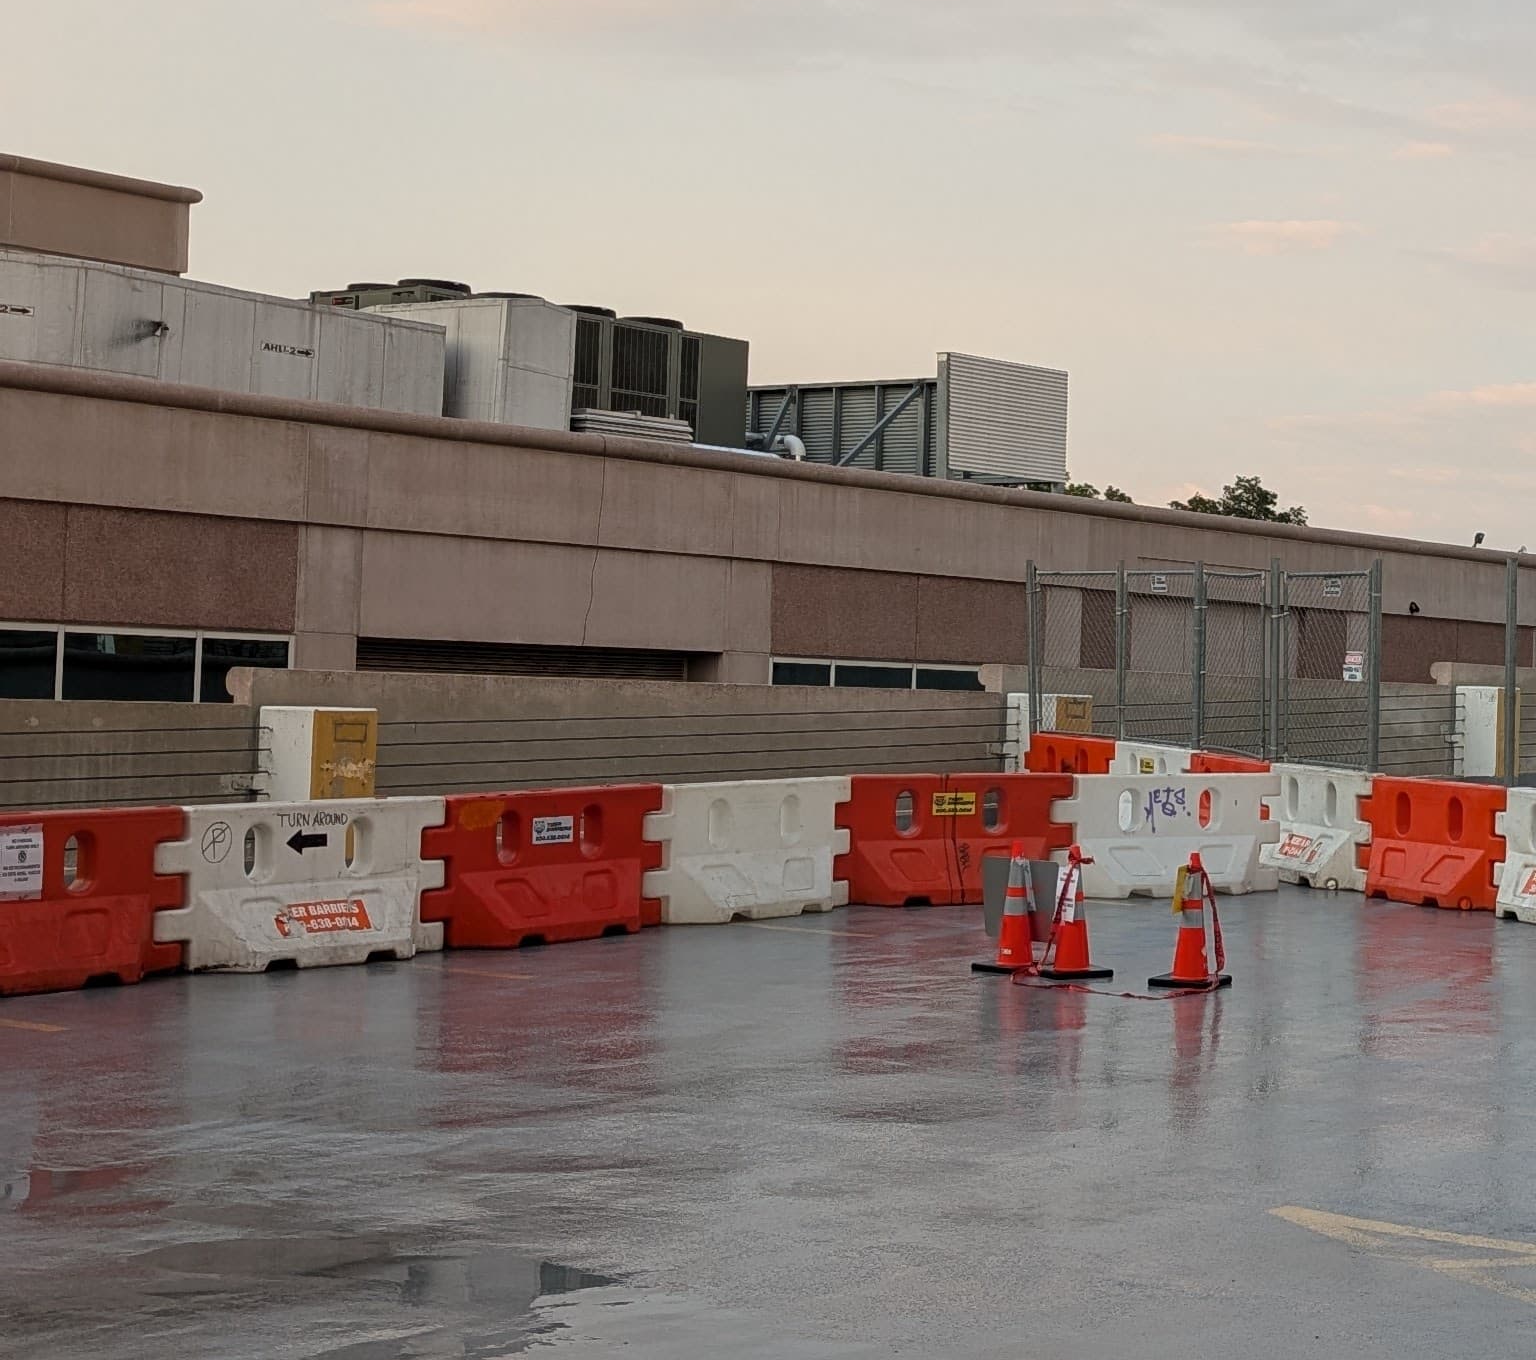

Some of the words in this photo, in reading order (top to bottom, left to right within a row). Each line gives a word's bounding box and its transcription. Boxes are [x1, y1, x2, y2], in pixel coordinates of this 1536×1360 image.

[275, 812, 311, 828] TURN
[312, 811, 349, 827] AROUND
[308, 902, 360, 916] BARRIES
